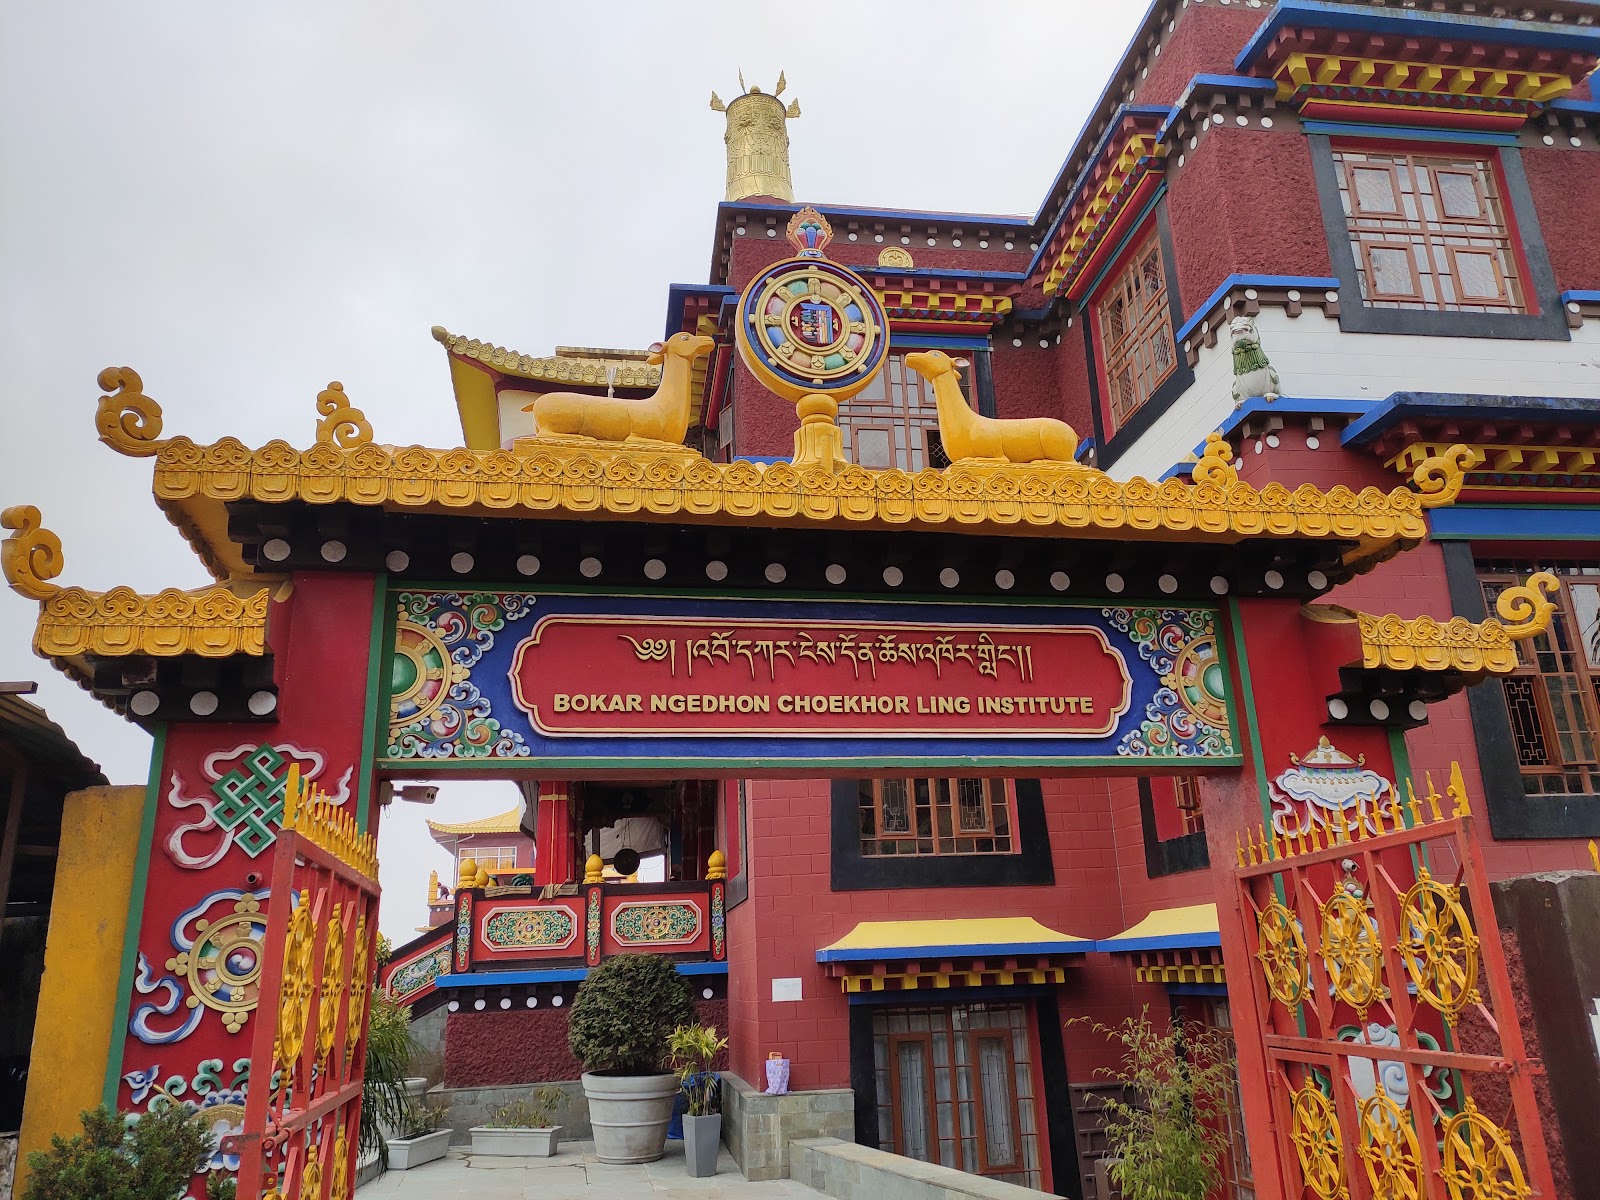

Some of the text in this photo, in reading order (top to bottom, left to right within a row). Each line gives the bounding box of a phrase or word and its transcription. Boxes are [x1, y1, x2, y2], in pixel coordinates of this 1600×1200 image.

[553, 693, 1094, 714] BOKAR NGEDHON CHOEKHOR LING INSTITUTE
